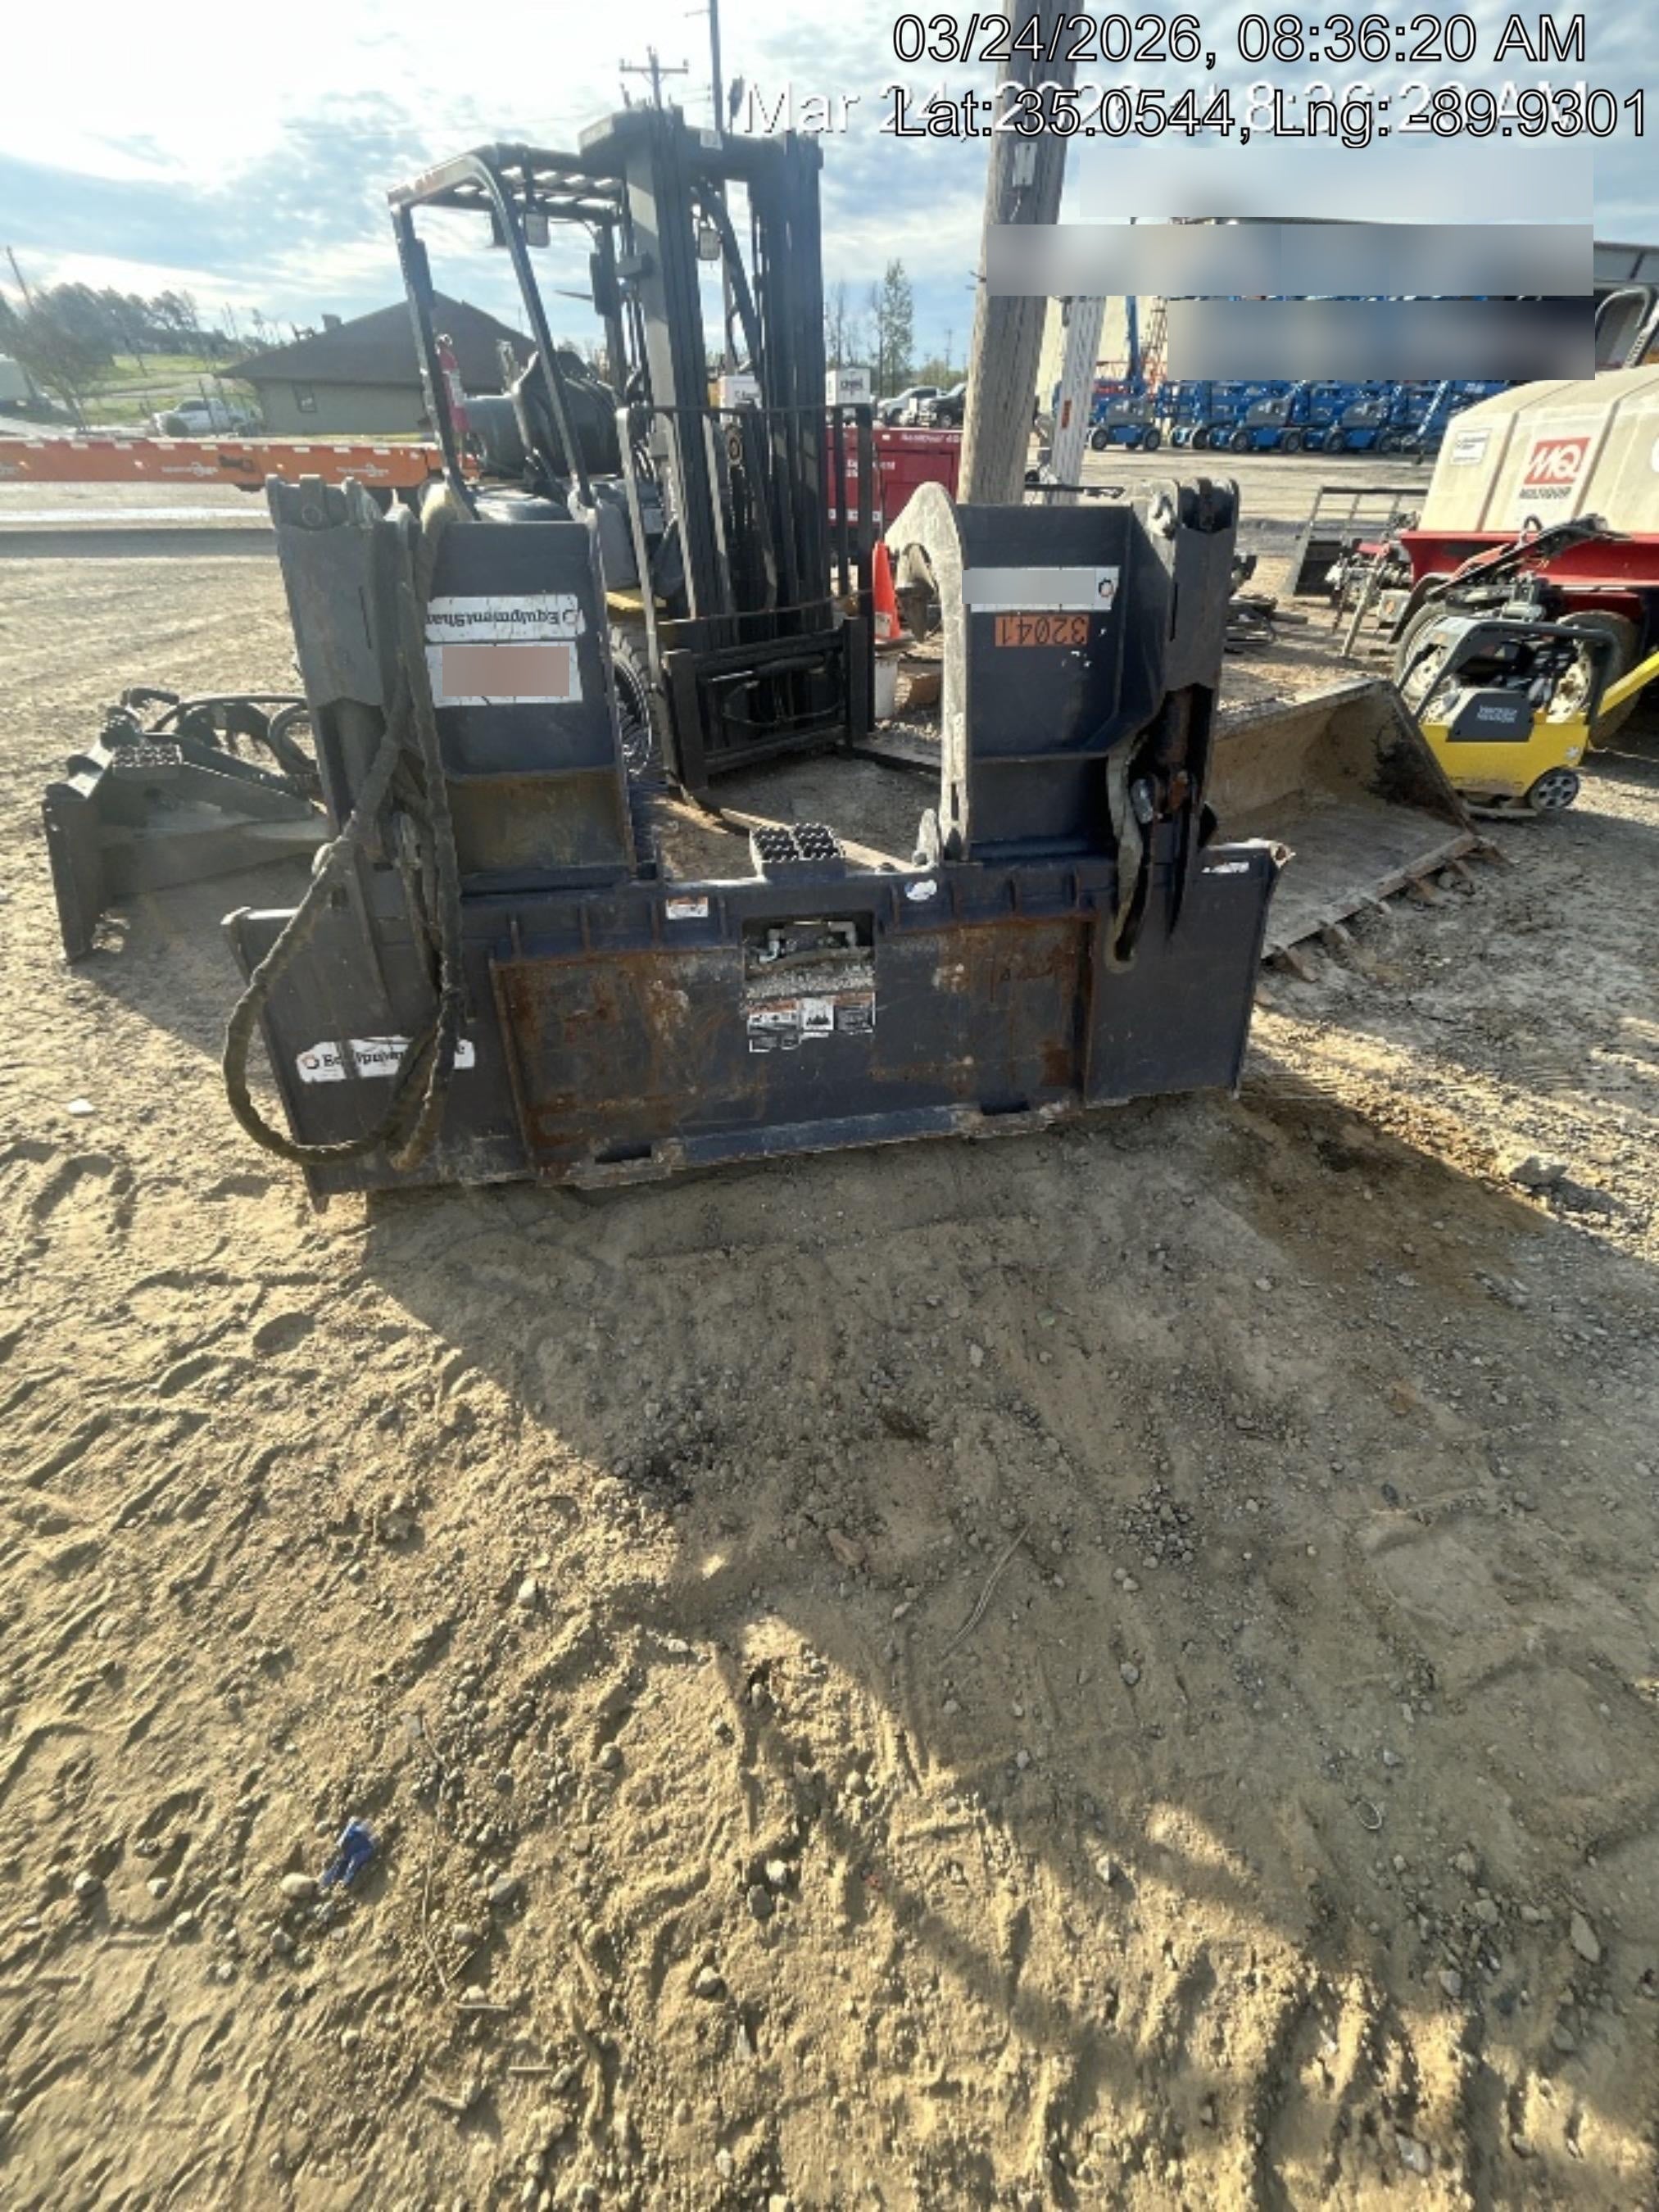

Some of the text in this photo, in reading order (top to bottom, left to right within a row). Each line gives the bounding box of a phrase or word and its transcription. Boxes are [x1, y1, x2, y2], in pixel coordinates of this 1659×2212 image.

[1527, 442, 1583, 480] MQ
[425, 609, 560, 628] EquipmentShar
[1001, 616, 1086, 646] 32041
